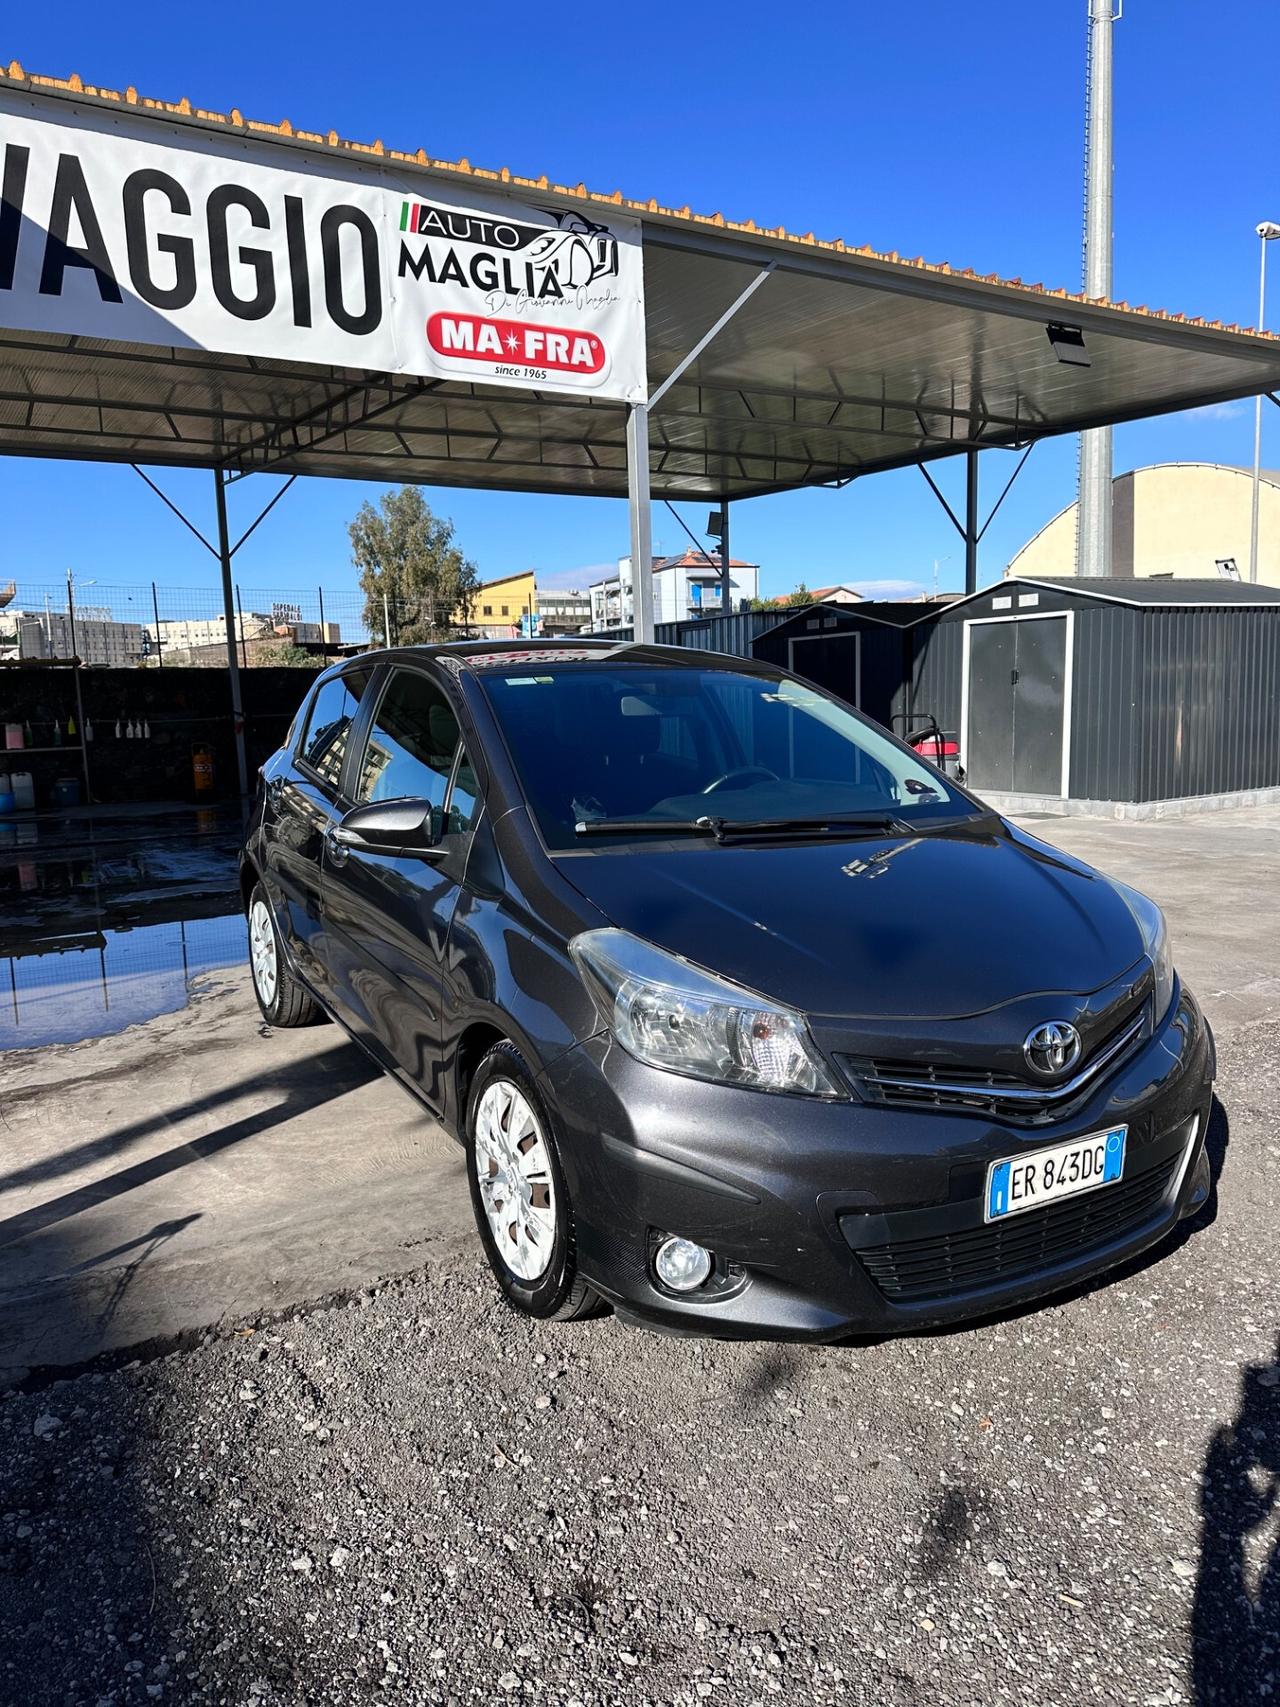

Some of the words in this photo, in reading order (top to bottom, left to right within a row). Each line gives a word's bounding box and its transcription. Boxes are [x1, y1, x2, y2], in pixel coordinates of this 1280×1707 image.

[421, 210, 519, 247] AUTO
[398, 238, 564, 298] MAGLIA
[495, 364, 521, 377] since
[523, 367, 547, 380] 1965
[1011, 1164, 1036, 1200] ER
[1043, 1145, 1105, 1191] 843DG
